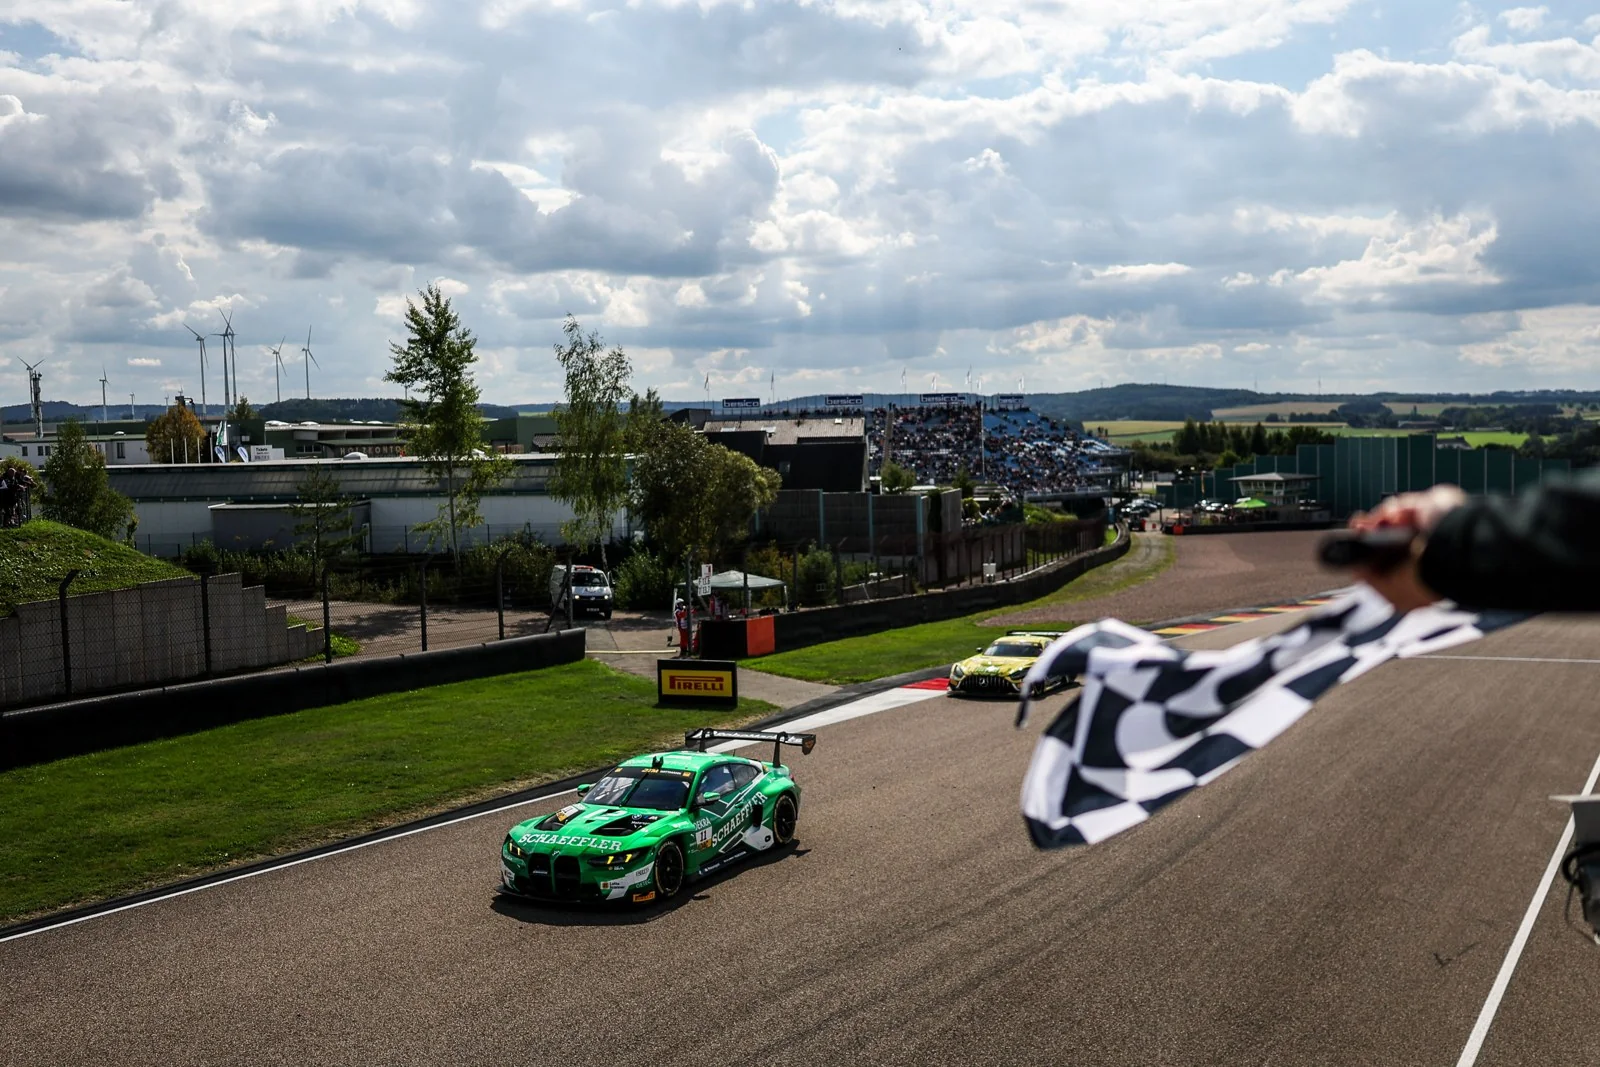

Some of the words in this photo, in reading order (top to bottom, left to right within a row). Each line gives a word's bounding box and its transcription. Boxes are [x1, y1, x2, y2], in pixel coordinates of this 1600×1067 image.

[723, 399, 760, 407] besico
[826, 396, 863, 405] besico
[669, 675, 724, 691] PIRELLI
[700, 830, 707, 841] 11
[518, 833, 622, 851] SCHAEFFLER
